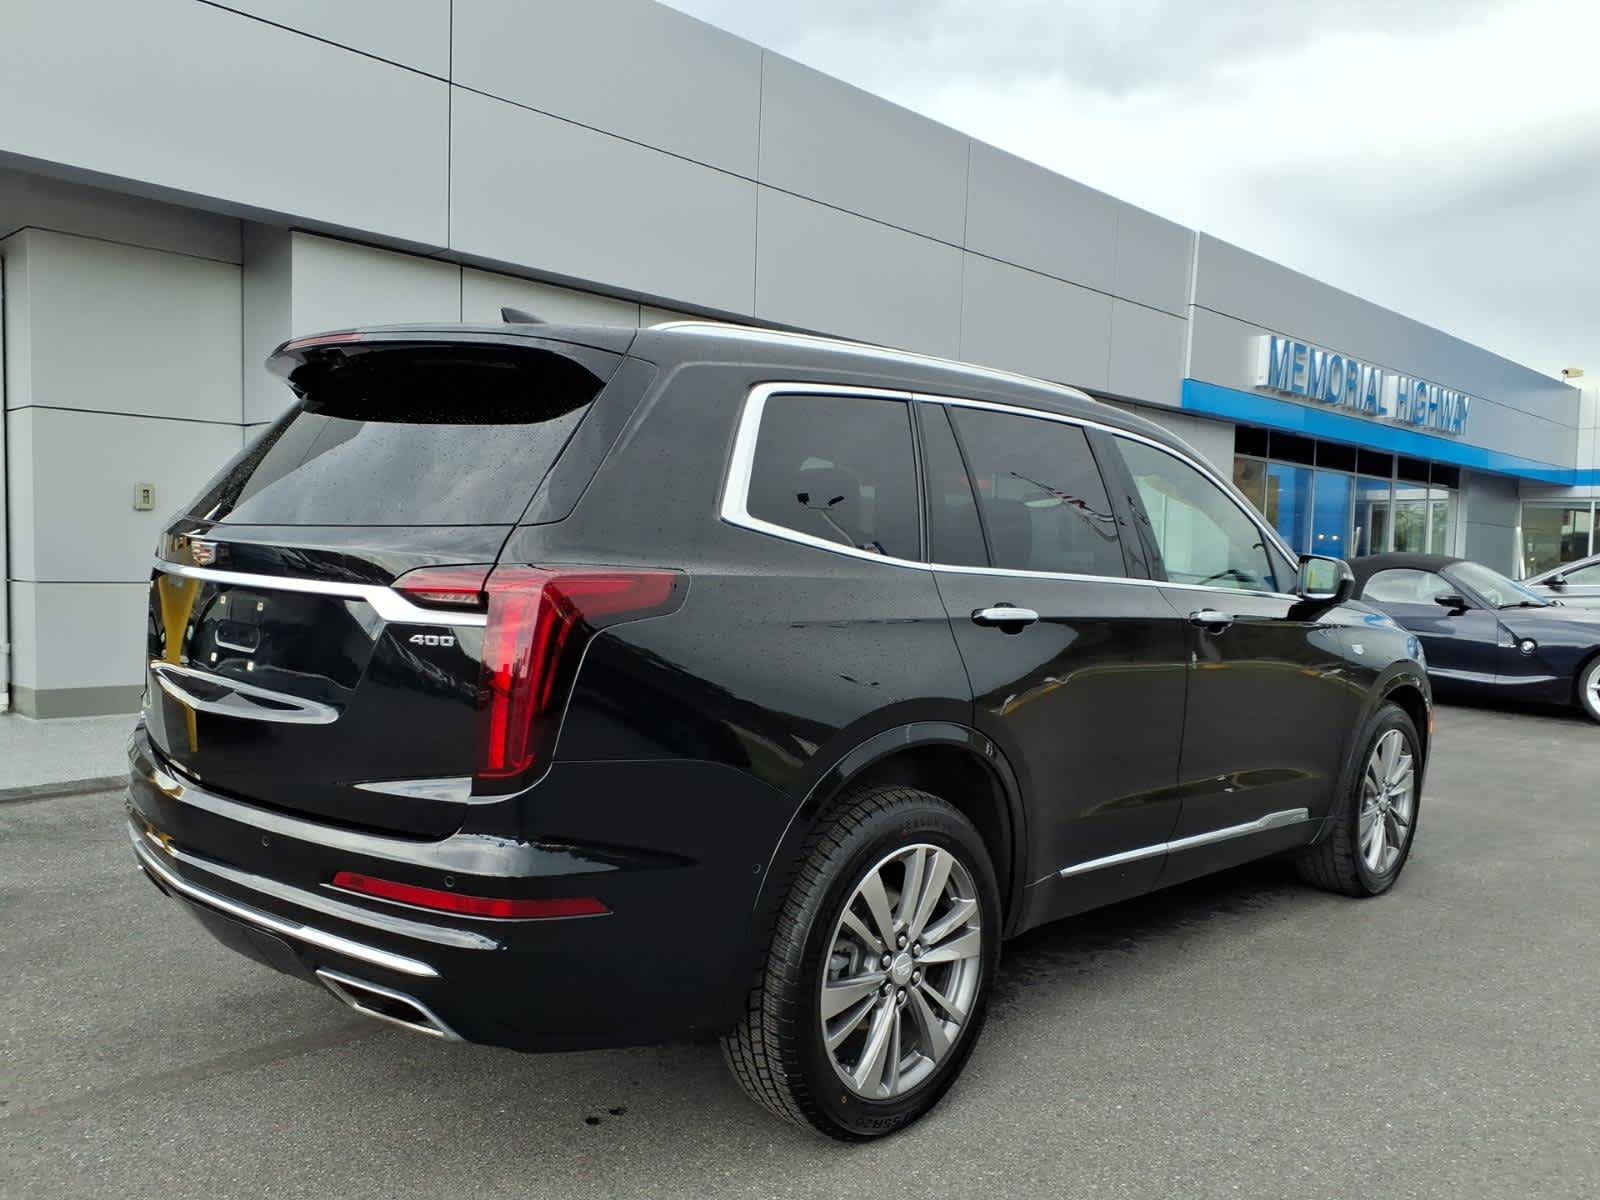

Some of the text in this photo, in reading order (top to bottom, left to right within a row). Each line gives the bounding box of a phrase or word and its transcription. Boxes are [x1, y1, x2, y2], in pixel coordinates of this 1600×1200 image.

[1265, 336, 1471, 434] MEMORIAL HIGHWAY
[409, 634, 455, 647] 400
